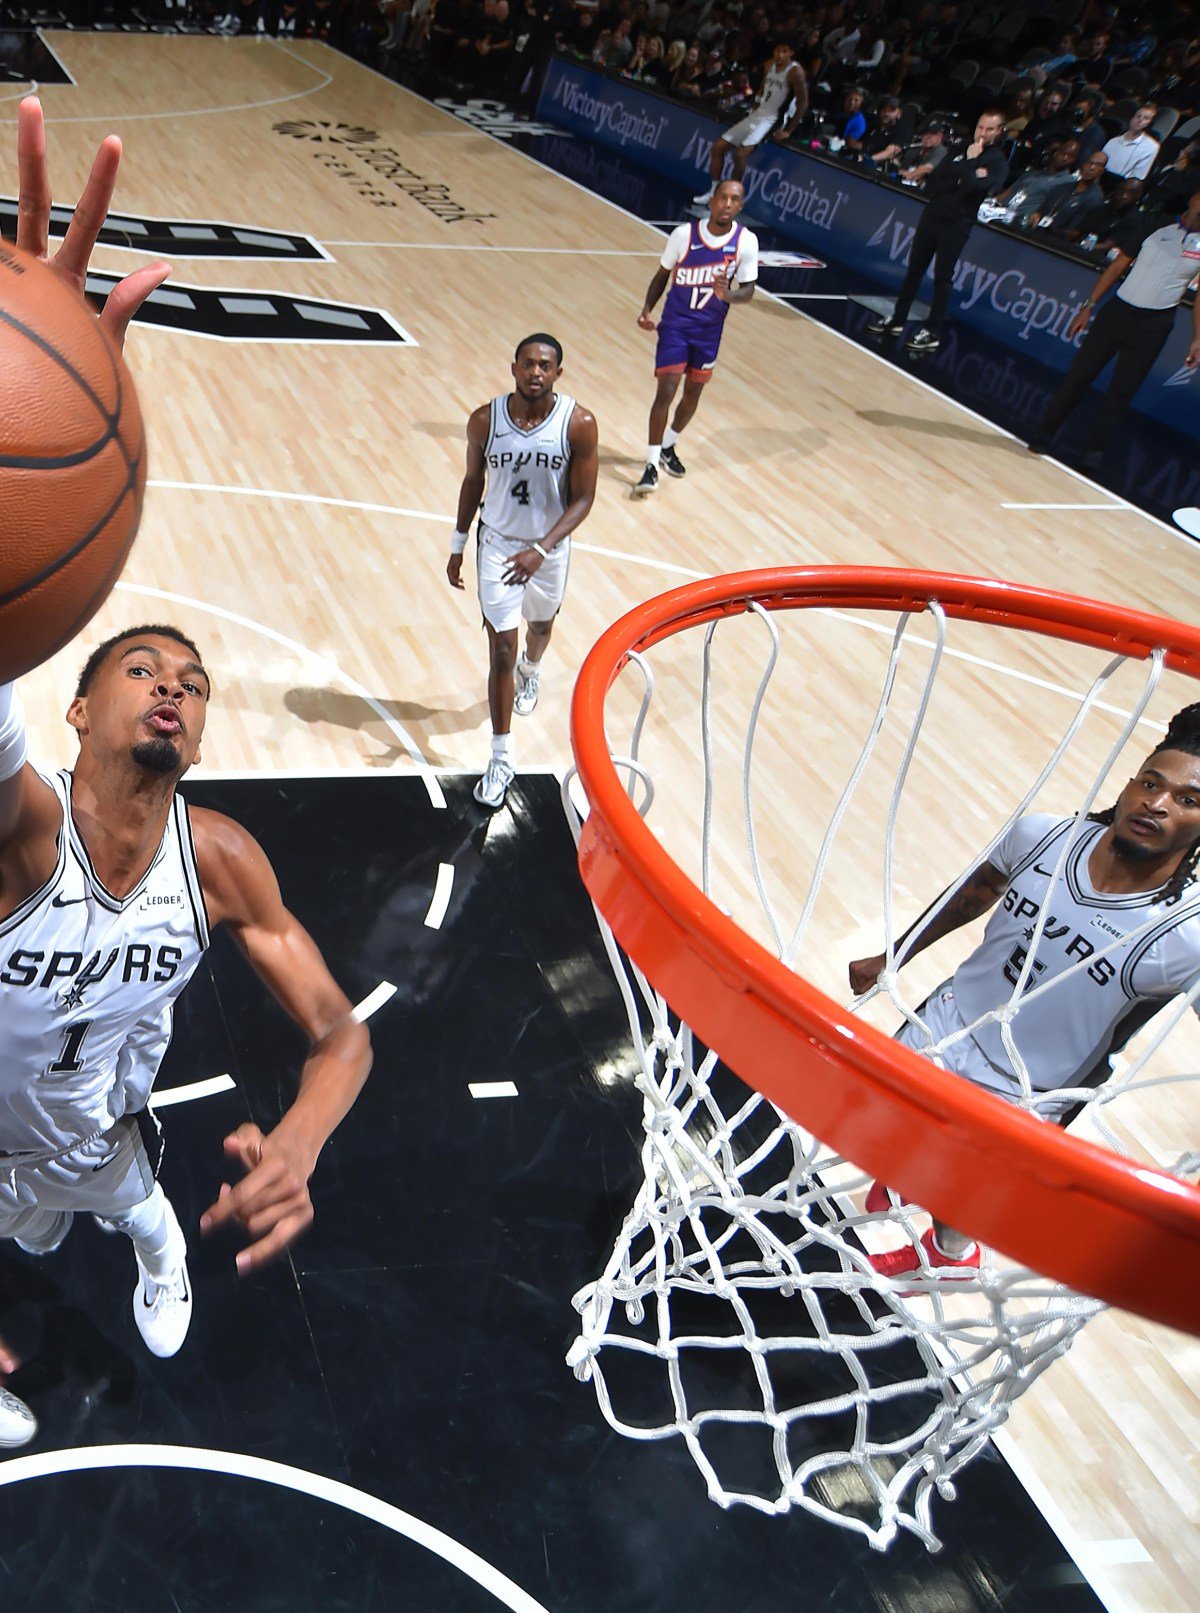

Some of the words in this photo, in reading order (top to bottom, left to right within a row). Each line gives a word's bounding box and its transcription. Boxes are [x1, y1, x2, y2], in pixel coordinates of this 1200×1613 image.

[394, 182, 498, 223] Bank
[690, 287, 714, 309] 17
[489, 451, 563, 474] SPURS
[511, 480, 530, 506] 4
[147, 895, 181, 906] LEDGER
[1003, 888, 1116, 987] SPURS
[0, 943, 183, 1008] SPURS
[1002, 941, 1047, 994] 5
[49, 1019, 94, 1074] 1
